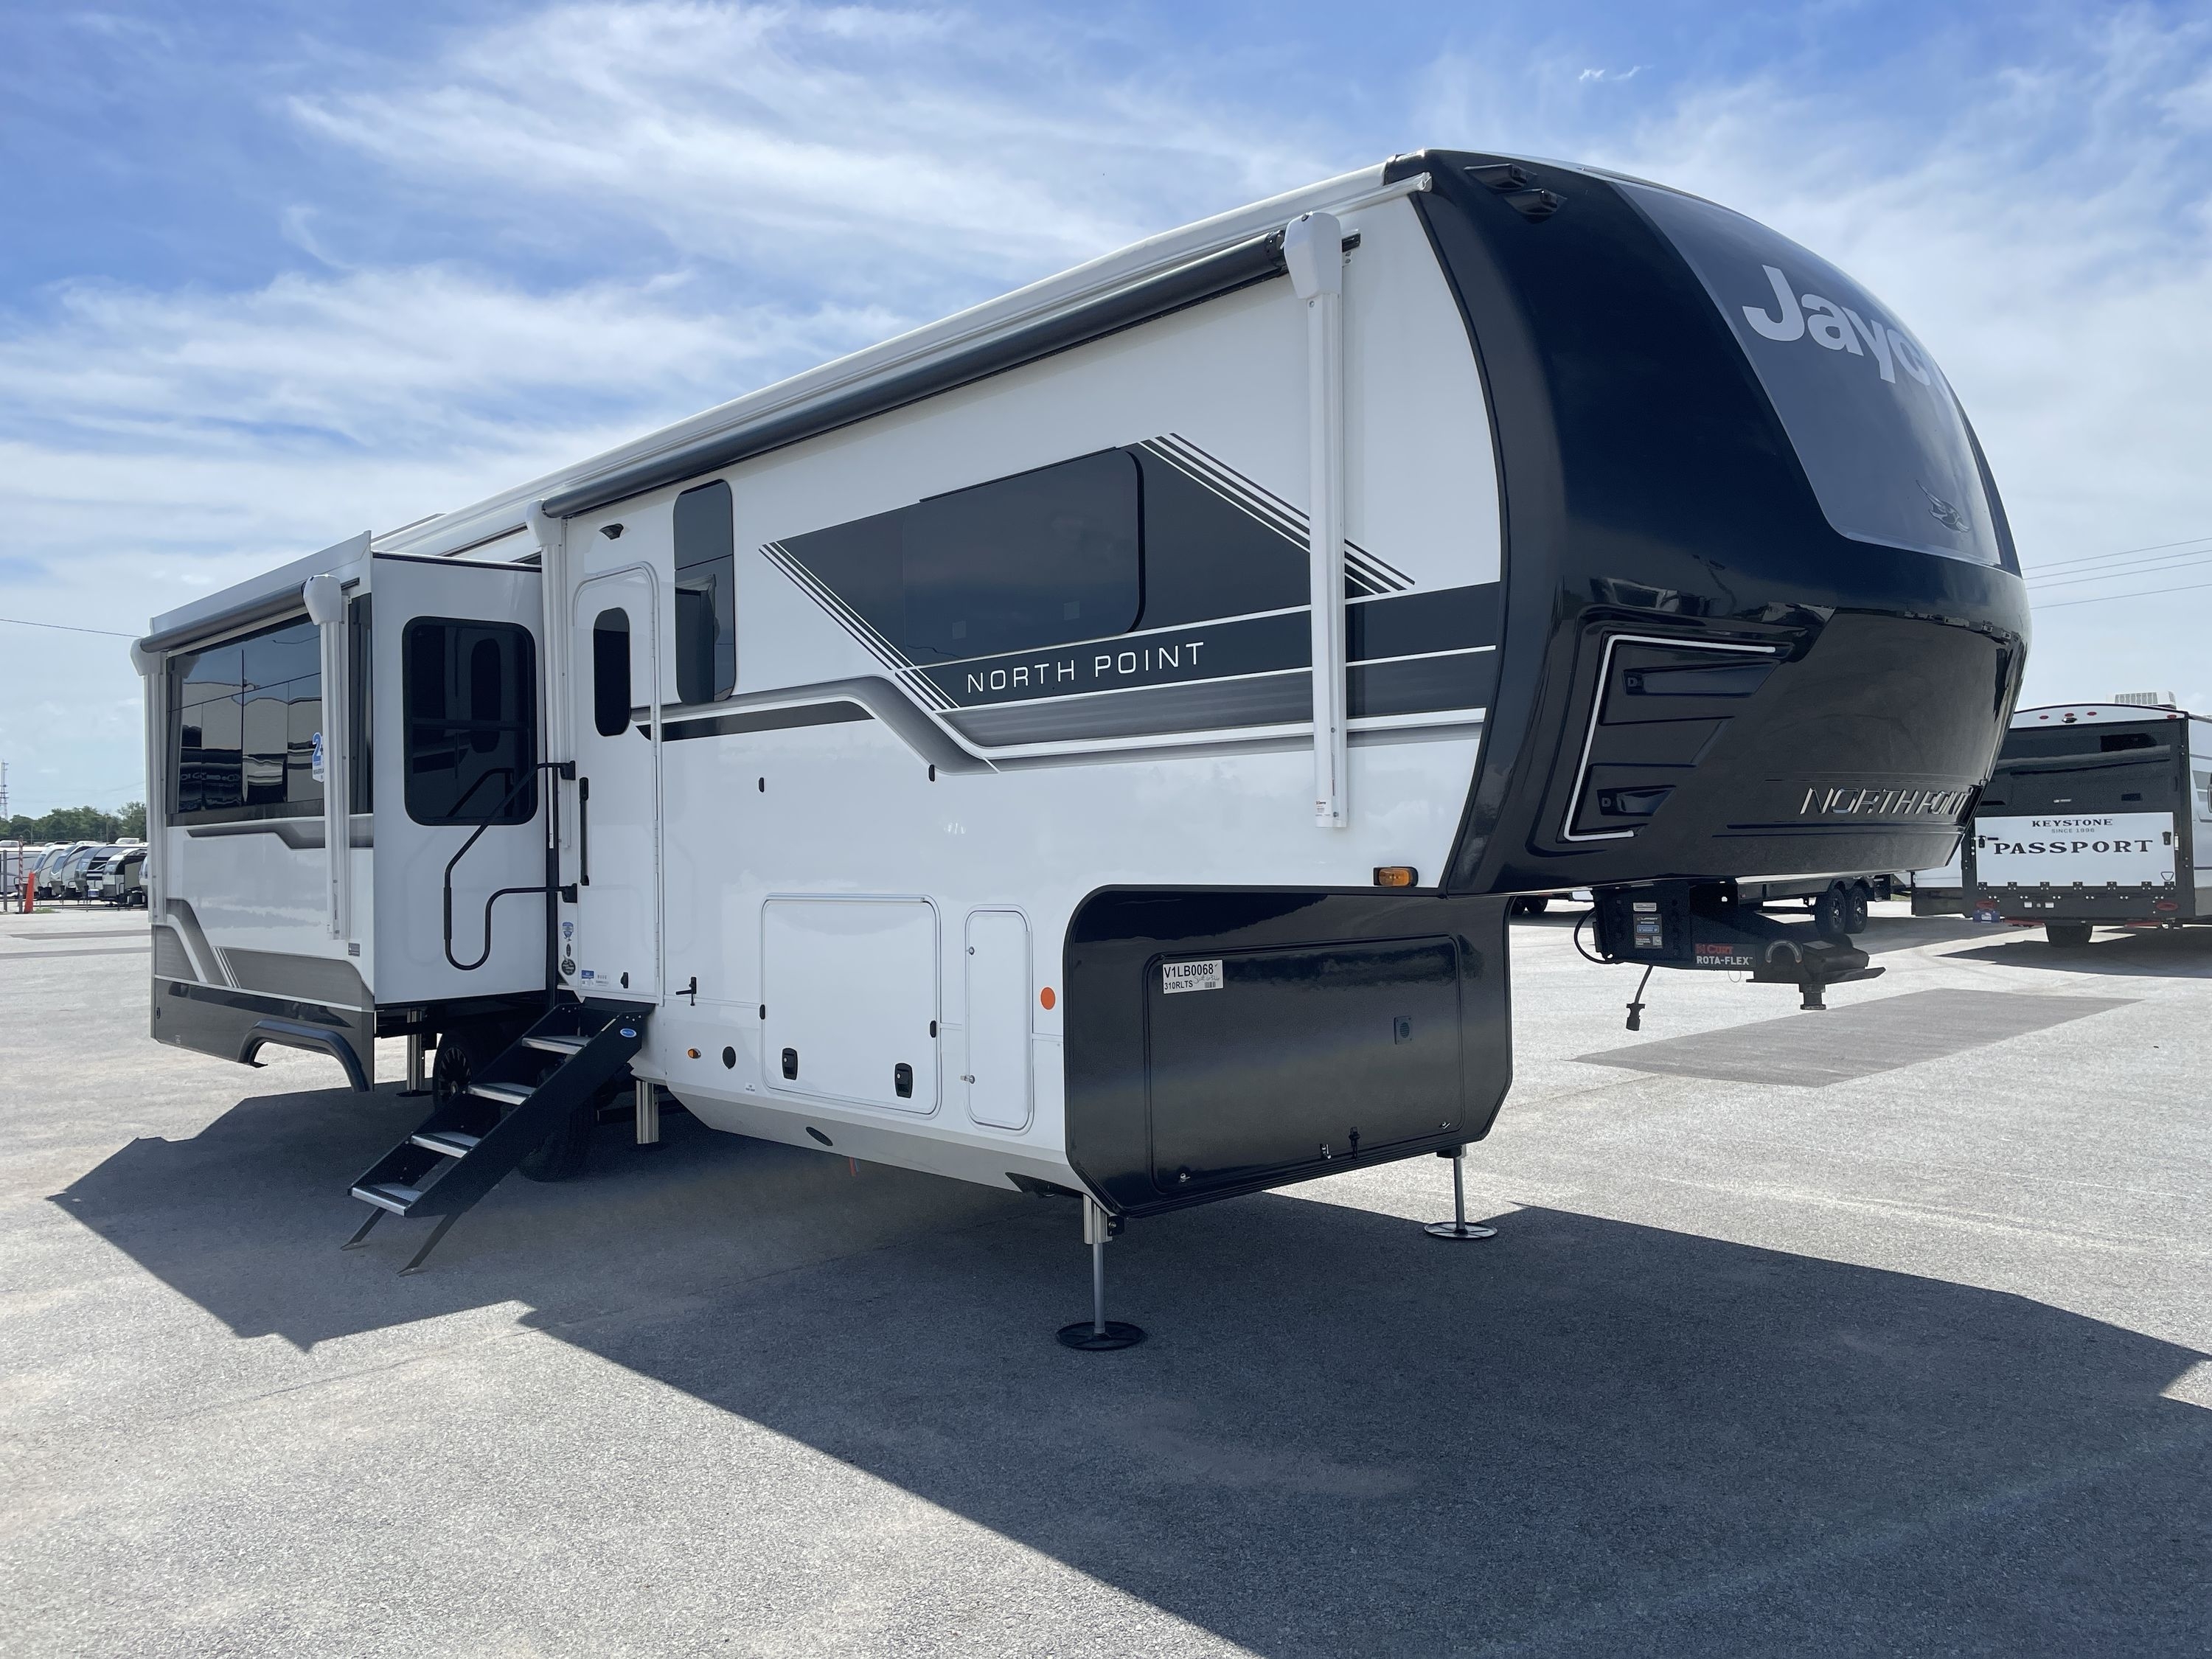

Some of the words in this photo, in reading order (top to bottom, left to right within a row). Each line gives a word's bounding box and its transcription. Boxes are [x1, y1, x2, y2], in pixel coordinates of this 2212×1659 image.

[967, 659, 1075, 694] NORTH
[1094, 641, 1204, 678] POINT
[1799, 787, 1919, 815] NORTH
[2031, 818, 2113, 827] KEYSTONE
[1994, 840, 2153, 855] PASSPORT
[1164, 963, 1214, 978] V1LB0068
[1164, 980, 1193, 990] 310RLTS
